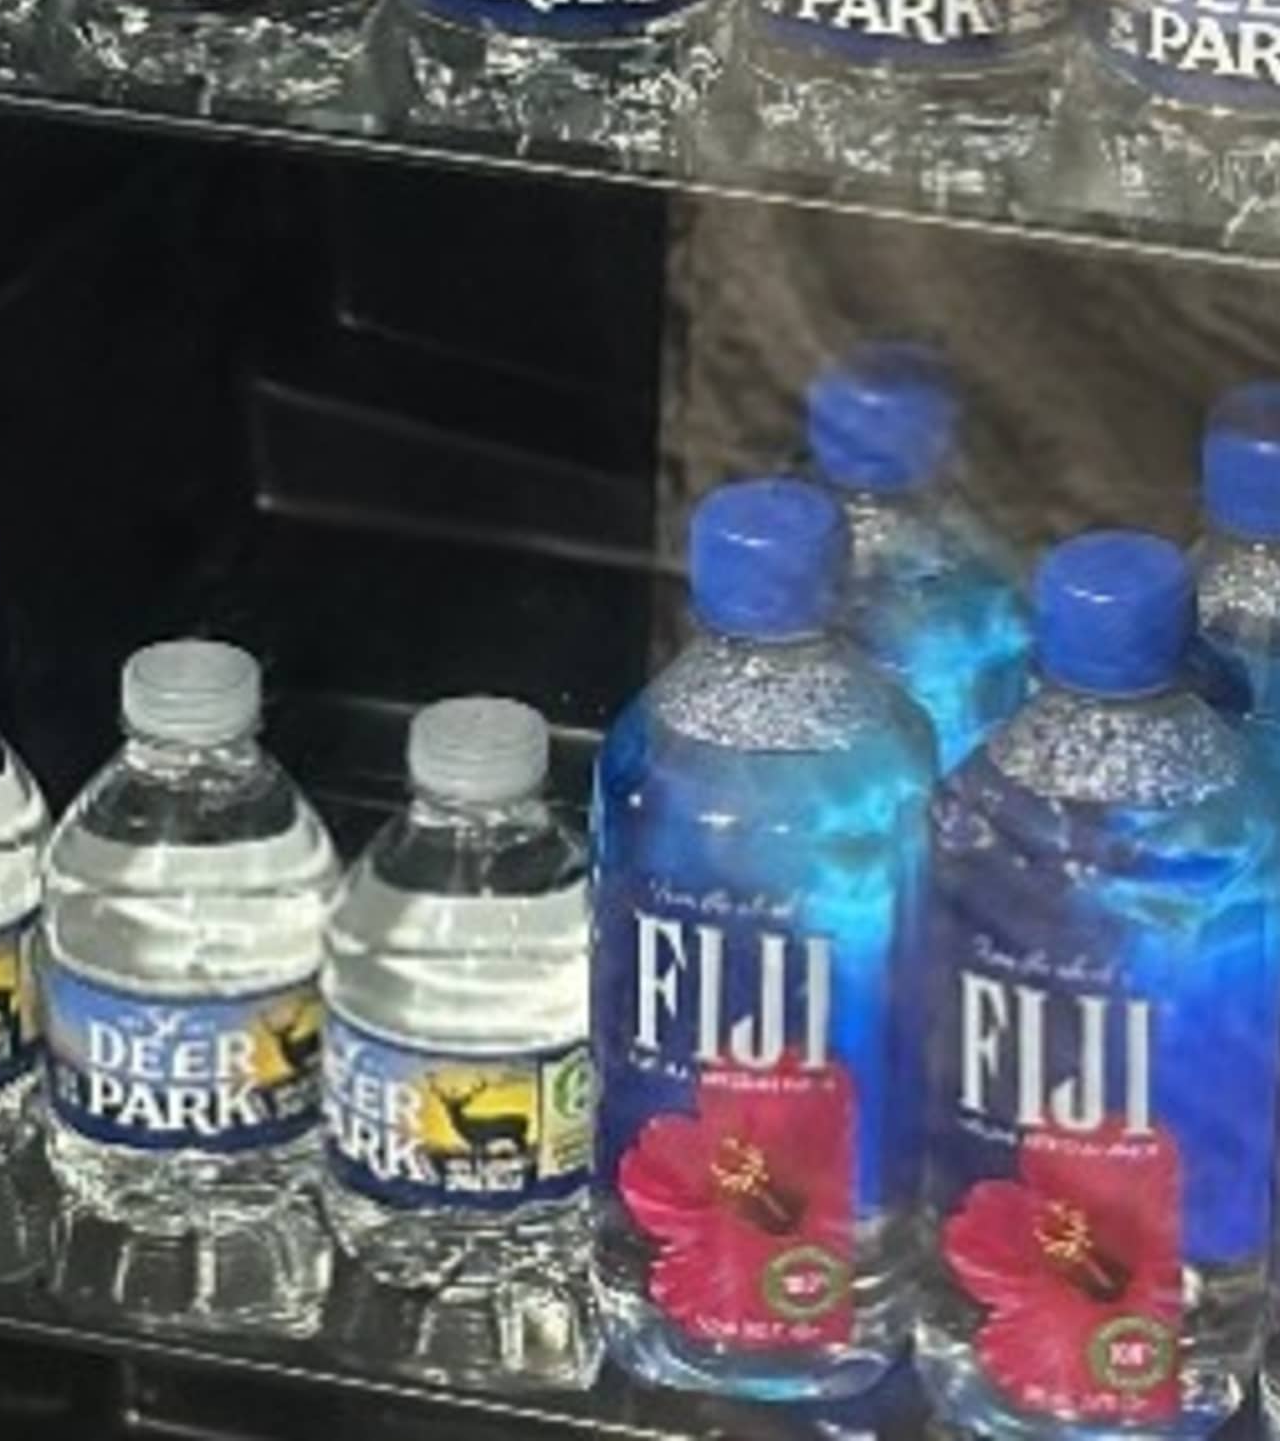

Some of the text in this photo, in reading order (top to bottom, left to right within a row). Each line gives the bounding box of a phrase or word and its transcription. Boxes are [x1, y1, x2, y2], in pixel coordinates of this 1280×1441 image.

[635, 909, 835, 1069] FIJI
[87, 1068, 260, 1136] PARK
[88, 1019, 256, 1081] DEER
[959, 969, 1154, 1135] FIJI
